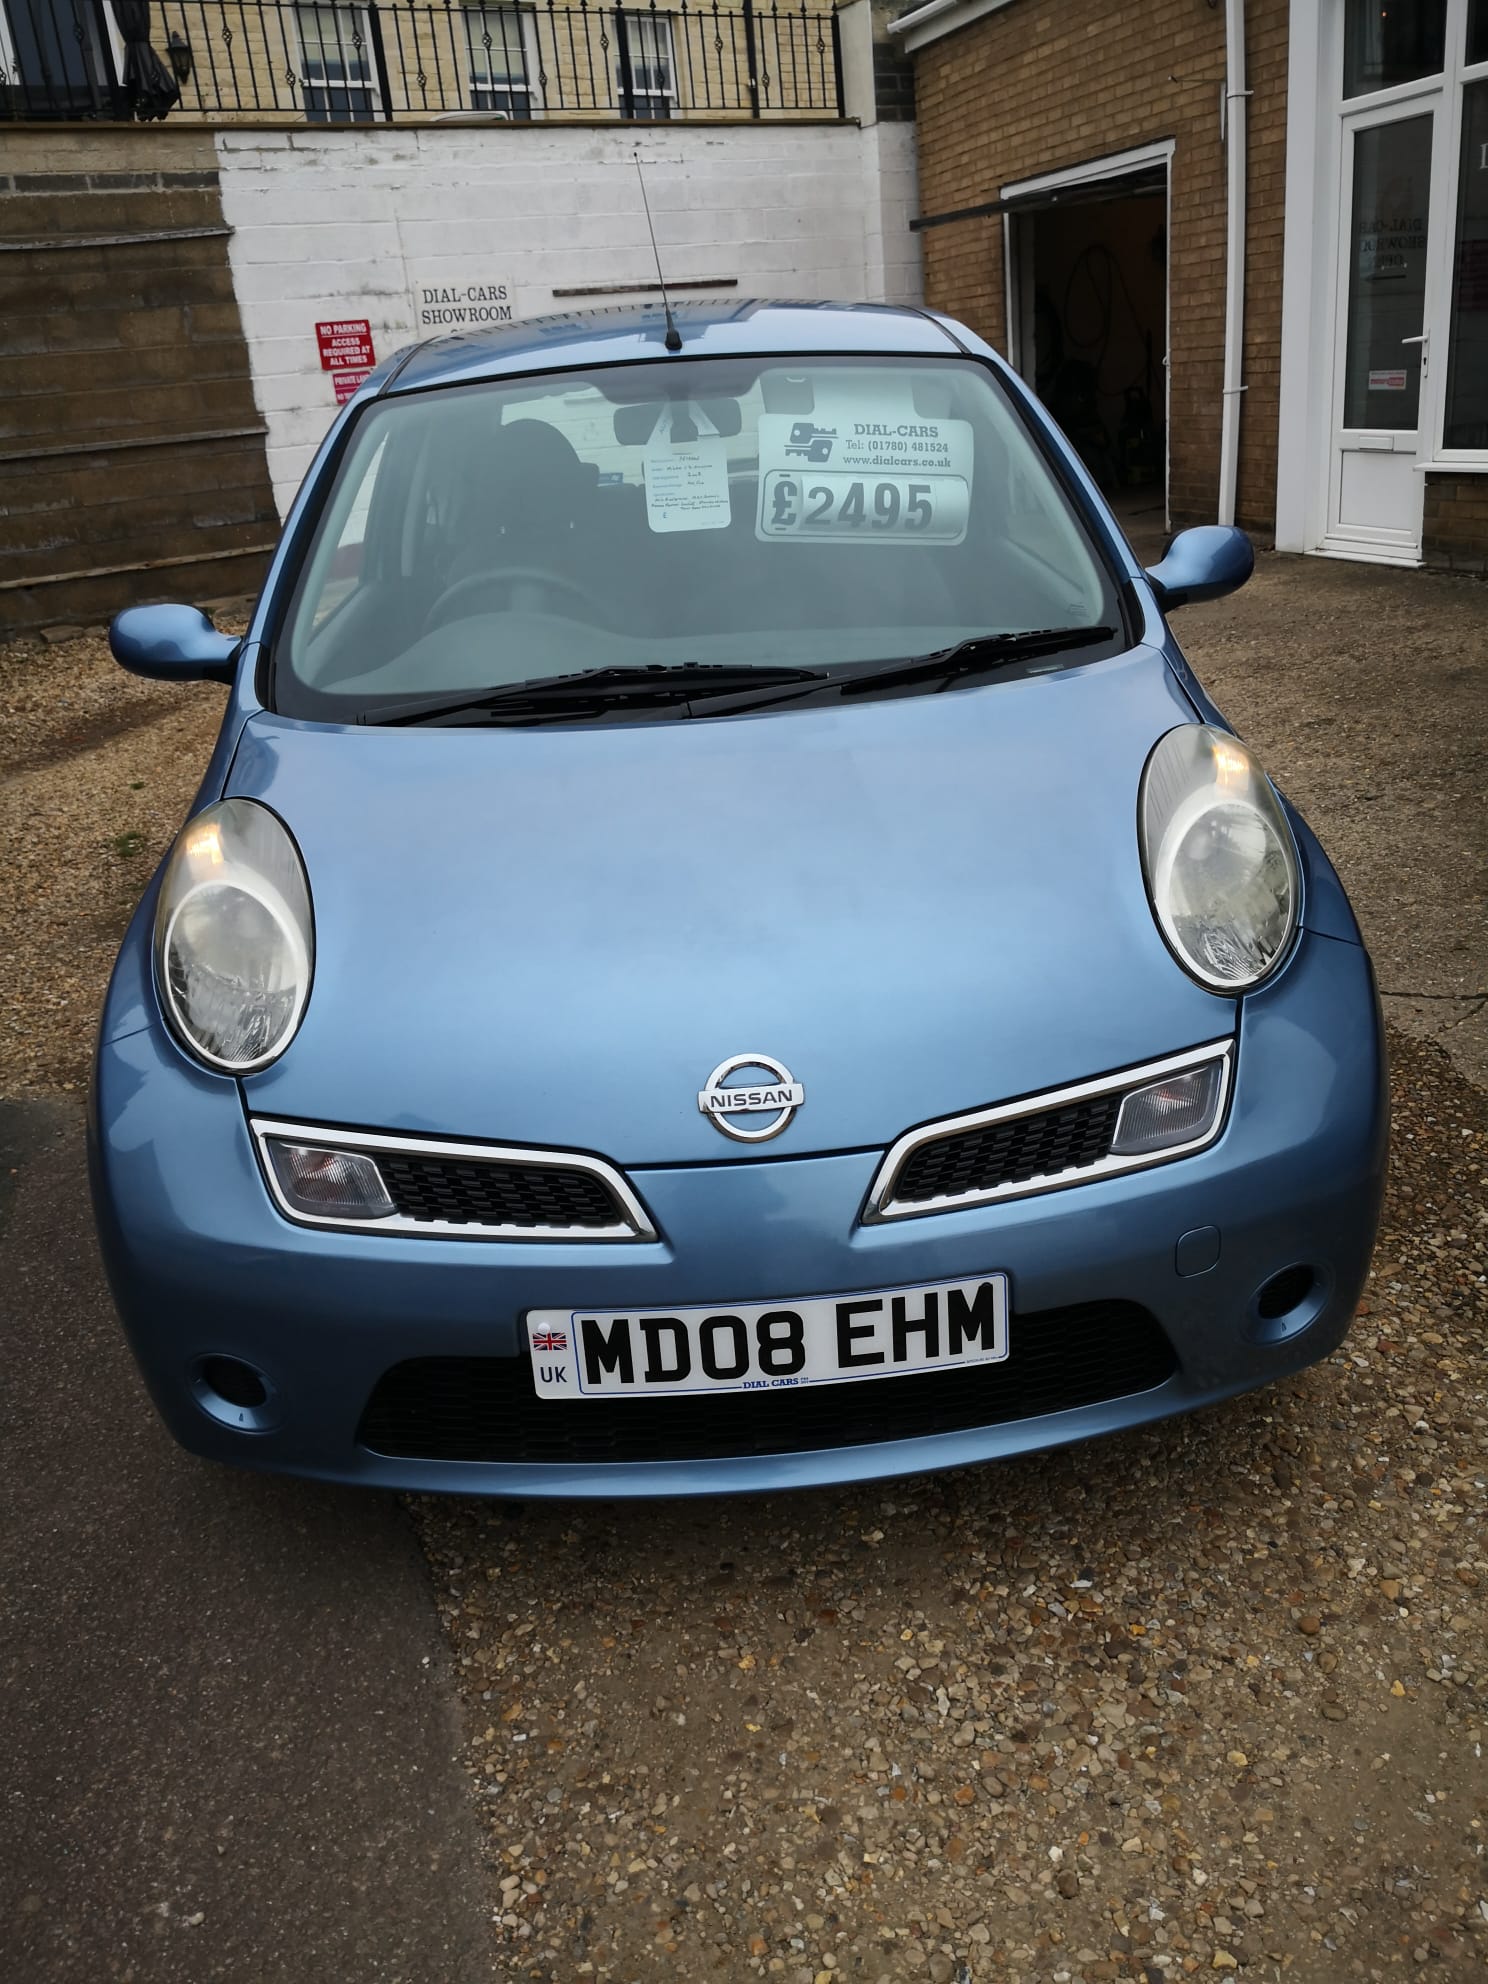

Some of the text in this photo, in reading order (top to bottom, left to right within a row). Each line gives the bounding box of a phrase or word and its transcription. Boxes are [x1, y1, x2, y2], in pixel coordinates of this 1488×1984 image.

[422, 286, 508, 304] DIAL-CARS
[421, 306, 512, 325] SHOWROOM
[320, 322, 367, 336] NO PARKING
[331, 337, 360, 347] ACCESS
[322, 345, 370, 357] REQUIRED AT
[330, 355, 368, 366] ALL TIMES
[853, 423, 939, 438] DIAL-CARS
[845, 440, 949, 453] Tel: (01780) 481524
[842, 455, 951, 468] www.dialcars.co.uk
[771, 480, 933, 531] £2495
[710, 1089, 793, 1108] NISSAN
[580, 1281, 996, 1385] MD08 EHM
[540, 1366, 568, 1384] UK
[742, 1380, 770, 1389] DIAL
[771, 1377, 799, 1387] CARS
